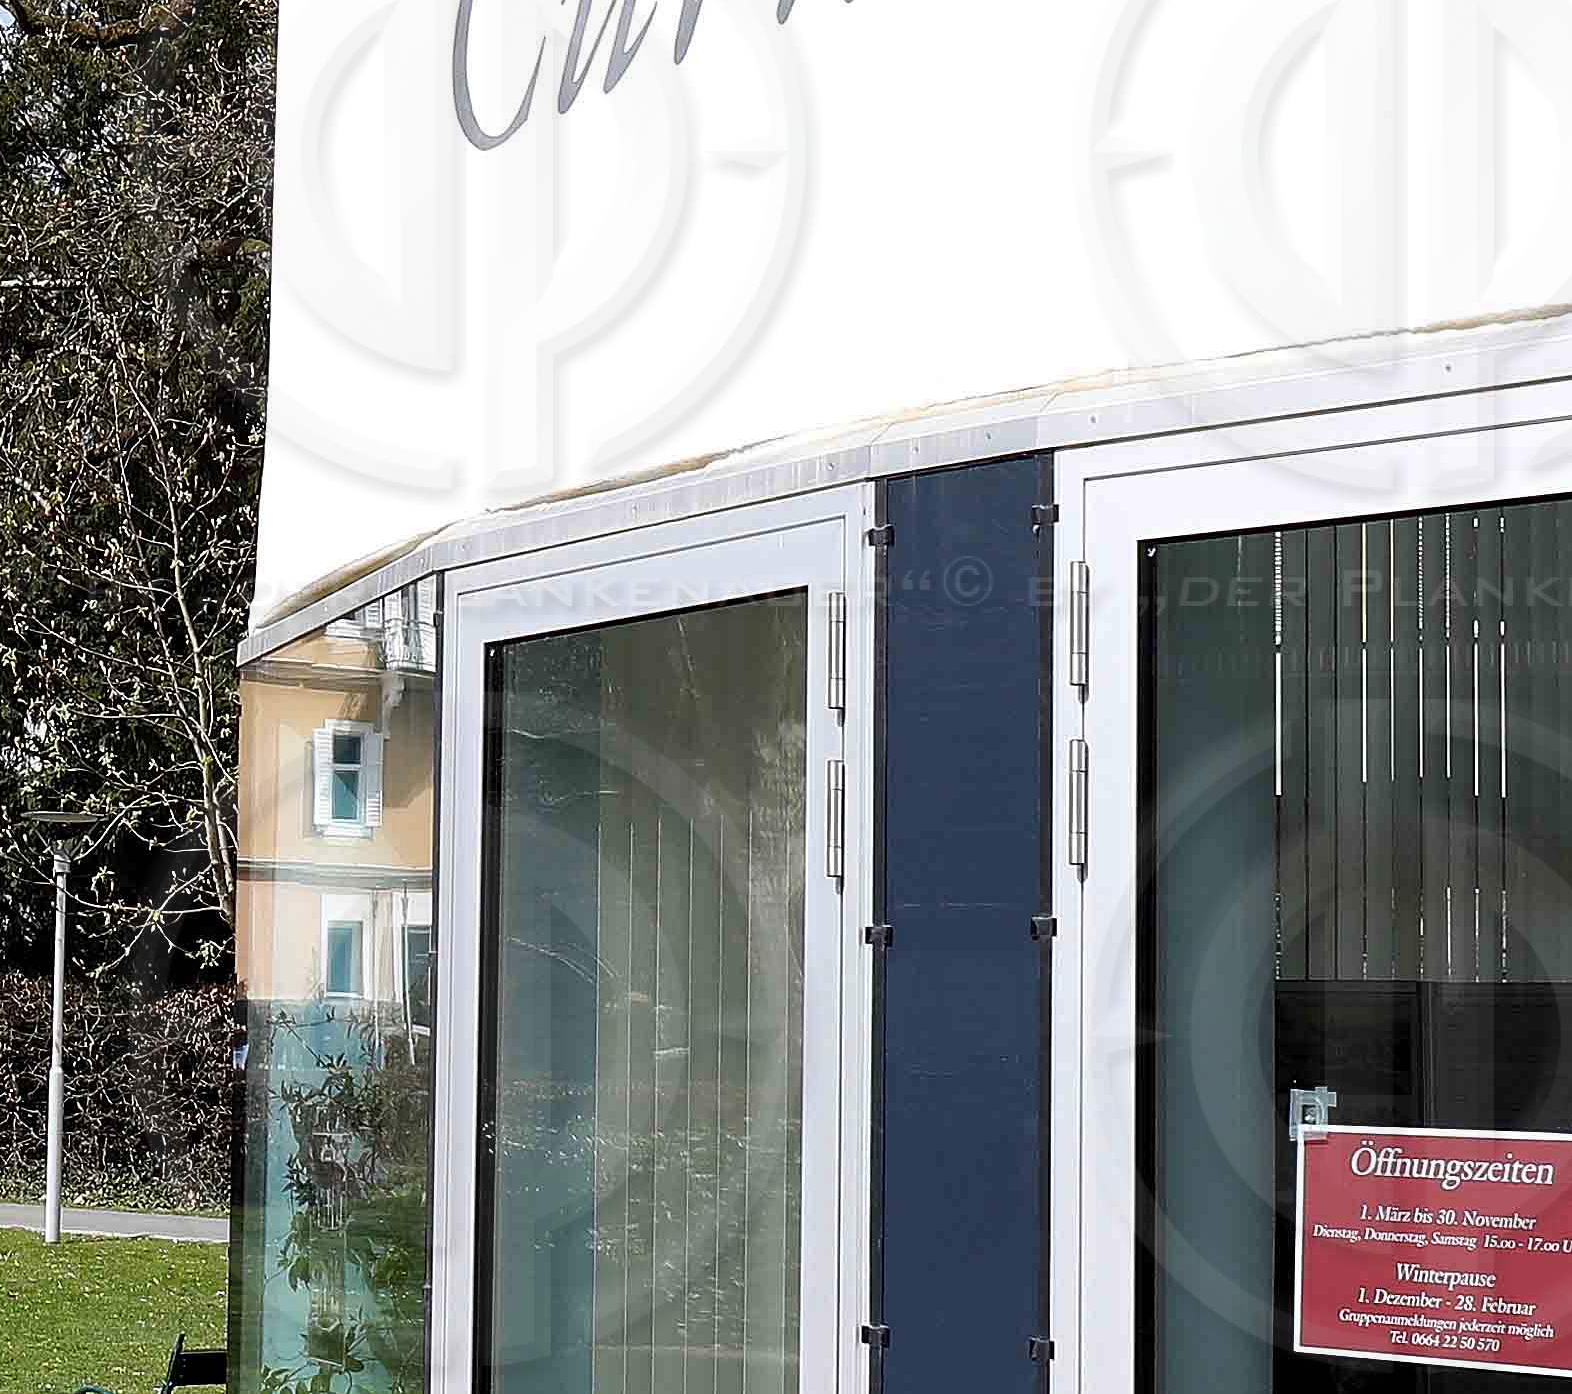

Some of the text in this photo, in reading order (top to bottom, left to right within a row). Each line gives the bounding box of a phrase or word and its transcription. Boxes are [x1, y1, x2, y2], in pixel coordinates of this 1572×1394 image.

[1351, 1140, 1554, 1190] Öffnungszeiten
[1359, 1204, 1536, 1231] 1. März bis 30. November
[1312, 1224, 1361, 1243] Dienstag,
[1364, 1227, 1429, 1247] Donnerstag,
[1431, 1232, 1477, 1252] Samstag
[1483, 1234, 1516, 1250] 15.00
[1527, 1237, 1560, 1253] 17.00
[1396, 1262, 1496, 1290] Winterpause
[1358, 1288, 1370, 1304] 1.
[1374, 1289, 1442, 1309] Dezember
[1454, 1295, 1477, 1311] 28.
[1481, 1296, 1536, 1316] Februar
[1339, 1309, 1554, 1340] Gruppenanmeldungen jederzeit möglich
[1411, 1331, 1440, 1347] 0664
[1442, 1334, 1457, 1348] 22
[1459, 1335, 1476, 1350] 50
[1477, 1336, 1500, 1352] 570
